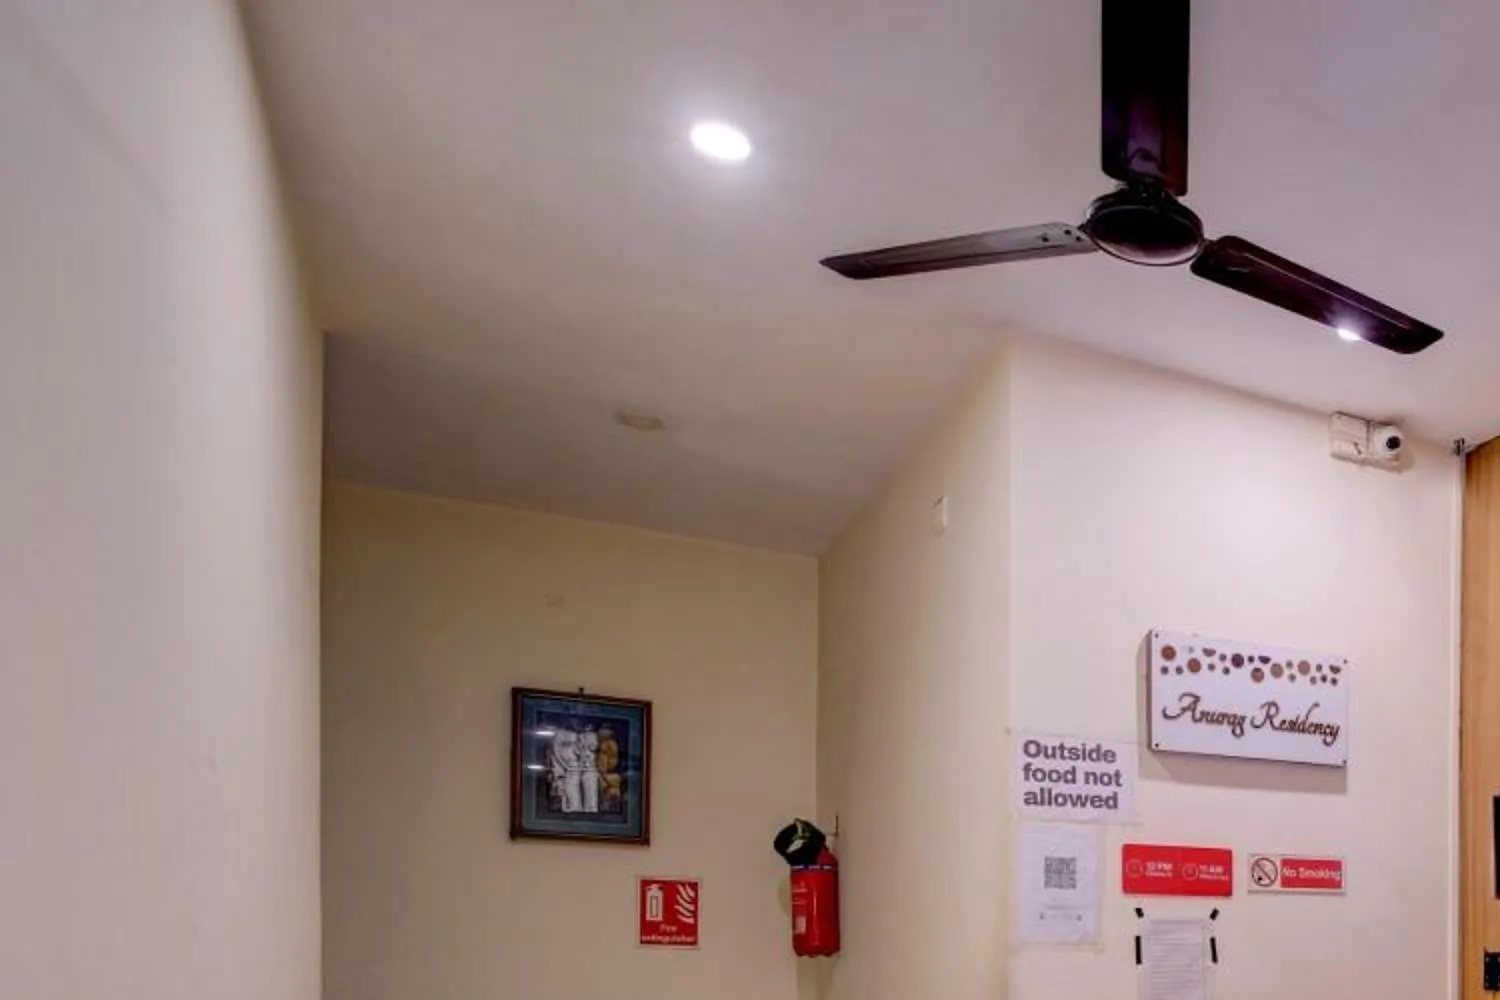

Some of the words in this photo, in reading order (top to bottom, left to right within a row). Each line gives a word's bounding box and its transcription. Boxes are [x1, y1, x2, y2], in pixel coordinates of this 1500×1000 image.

[1250, 701, 1341, 747] Residency
[1022, 739, 1117, 764] Outside
[1022, 762, 1077, 785] food
[1083, 769, 1122, 787] not
[1023, 787, 1119, 810] allowed
[1281, 865, 1296, 878] No
[1298, 866, 1342, 882] Smoking
